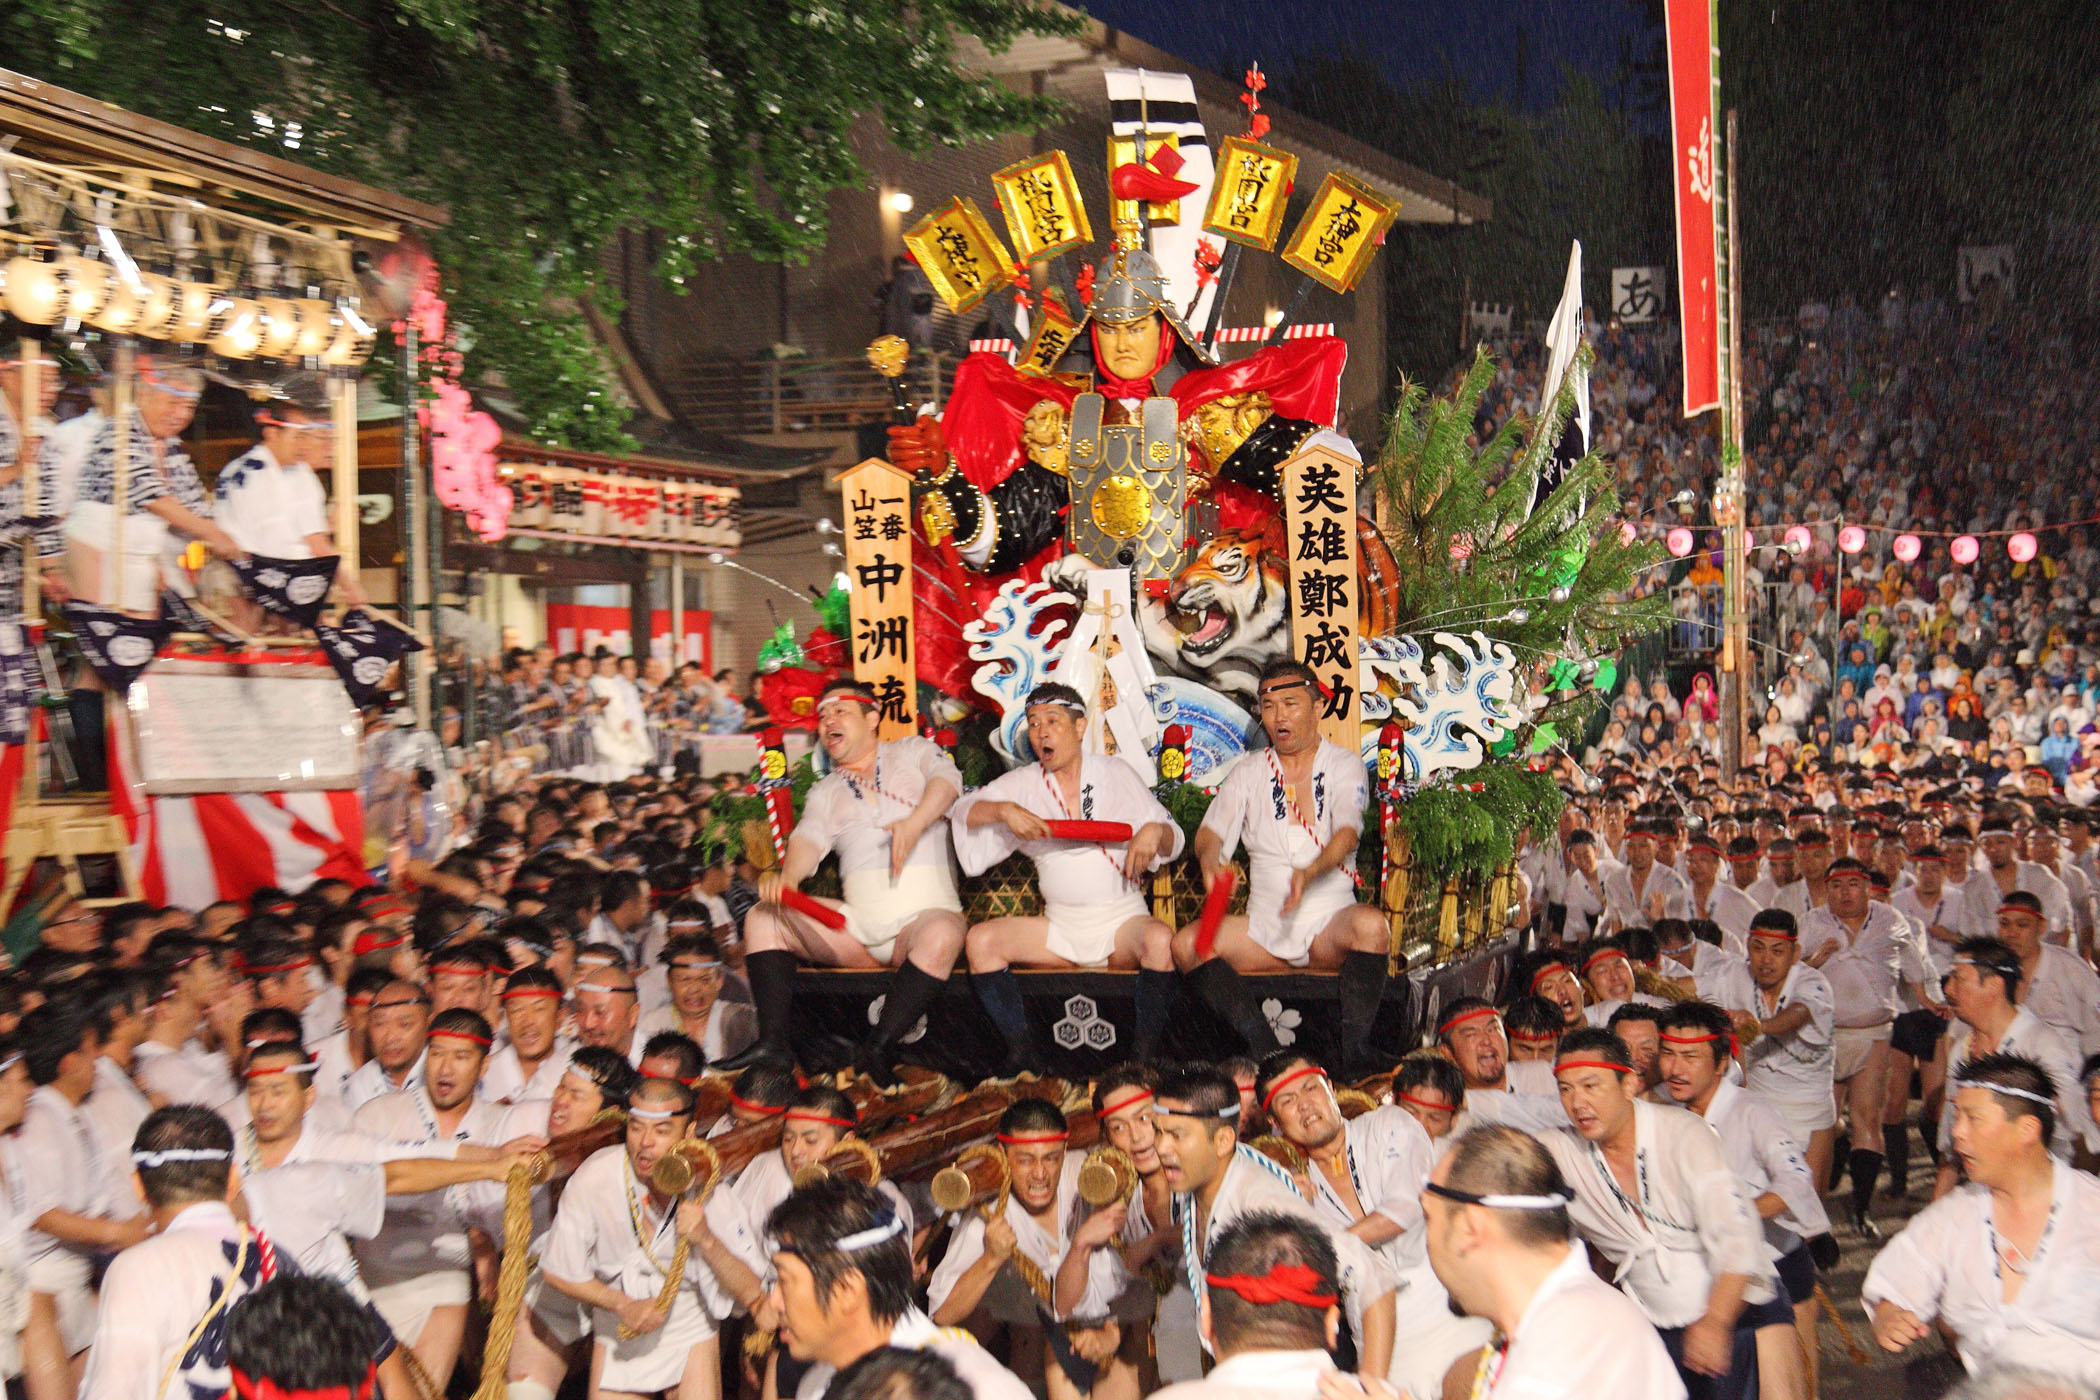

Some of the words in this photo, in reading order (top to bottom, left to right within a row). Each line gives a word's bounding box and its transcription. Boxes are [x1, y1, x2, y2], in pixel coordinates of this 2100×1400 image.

[1314, 198, 1362, 267] 大神宮
[1618, 271, 1660, 319] あ
[851, 488, 878, 541] 山笠
[879, 496, 908, 542] 一番
[855, 553, 913, 725] 中洲流
